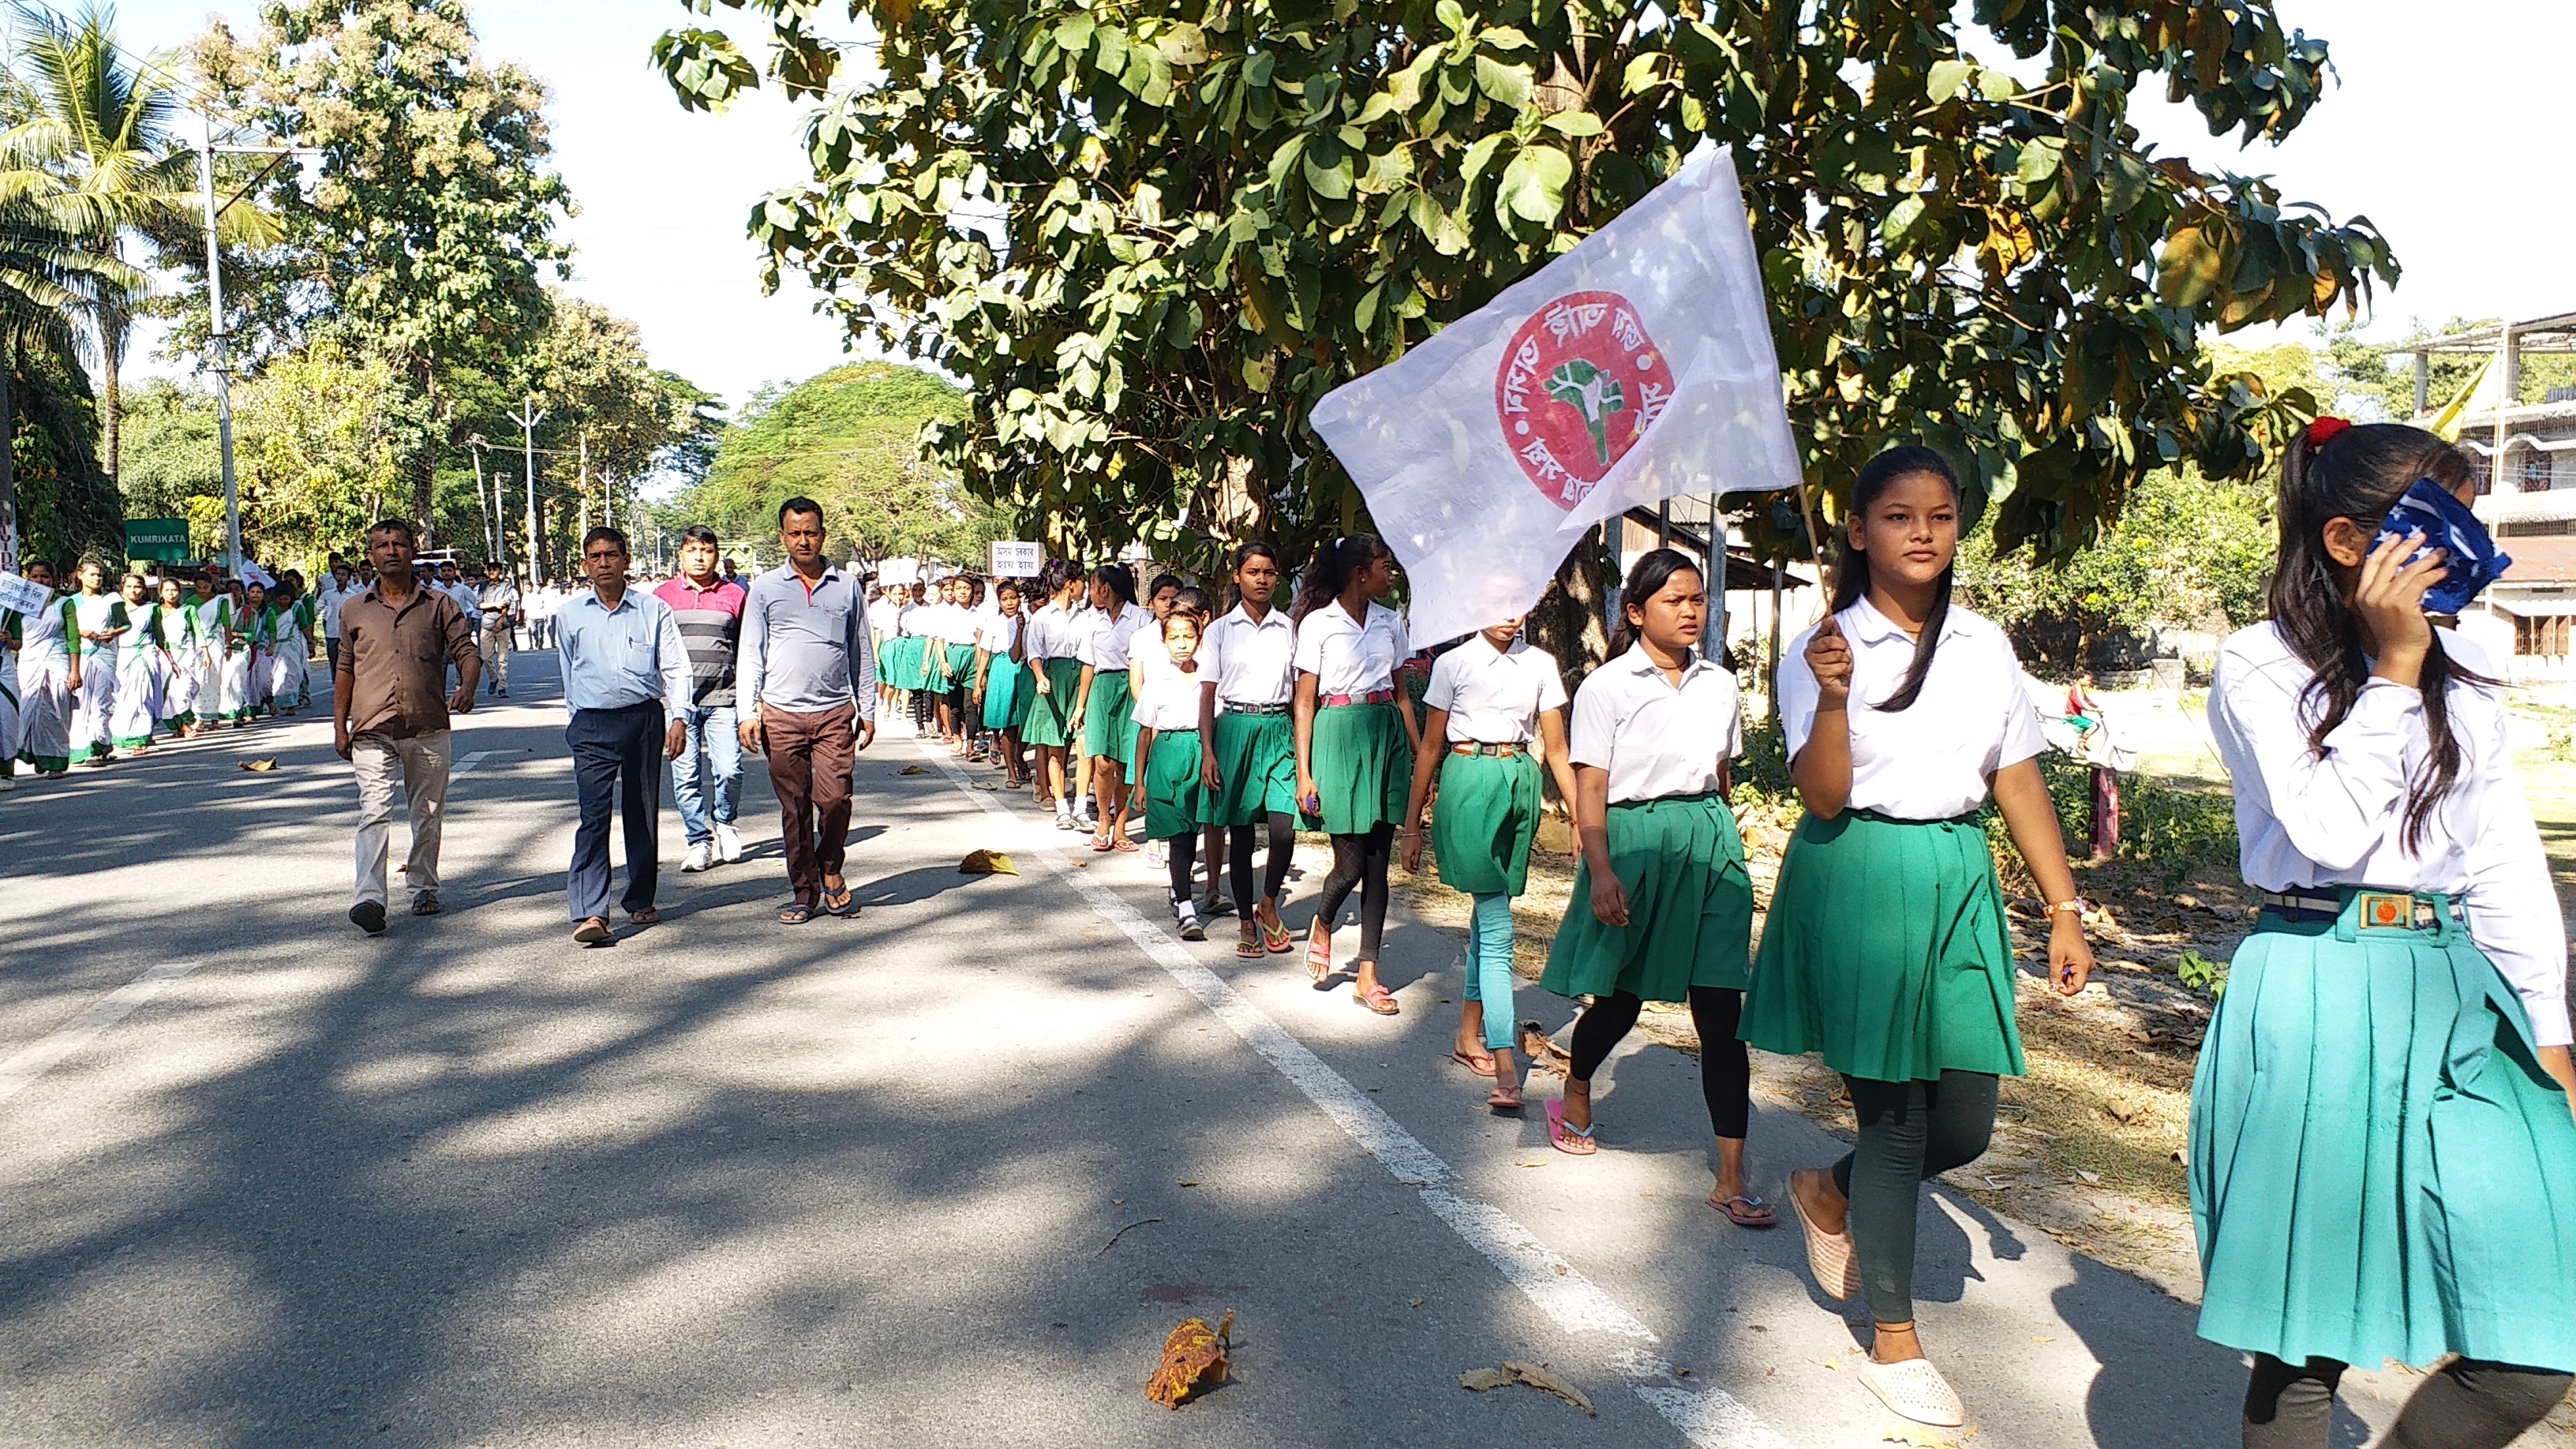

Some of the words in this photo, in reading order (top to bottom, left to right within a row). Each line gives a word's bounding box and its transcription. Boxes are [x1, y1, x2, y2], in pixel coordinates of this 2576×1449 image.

[130, 534, 186, 544] KUMRIKATA
[996, 547, 1013, 556] অসম
[996, 560, 1014, 569] হায়
[1017, 560, 1034, 570] হায়
